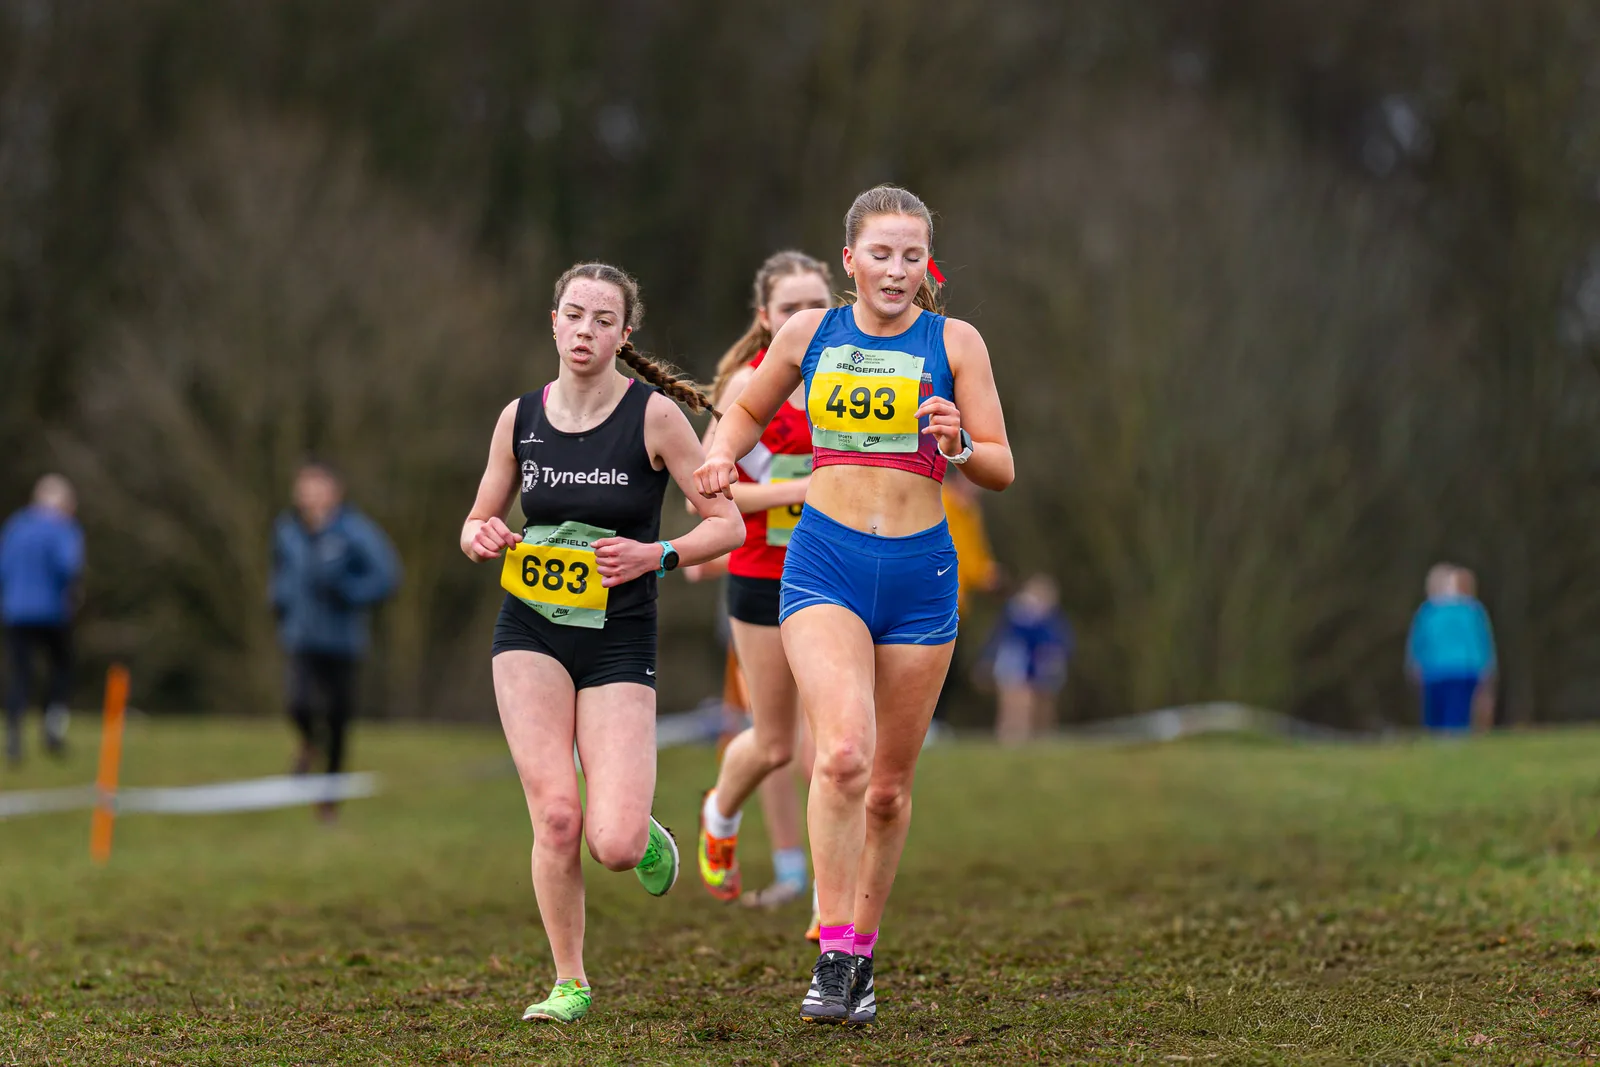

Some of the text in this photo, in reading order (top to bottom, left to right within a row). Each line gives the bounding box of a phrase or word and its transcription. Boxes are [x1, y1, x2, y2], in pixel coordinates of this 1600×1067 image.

[836, 362, 896, 374] SEDGEFIELD
[825, 384, 896, 421] 493
[541, 466, 629, 488] Tynedale
[521, 554, 590, 595] 683
